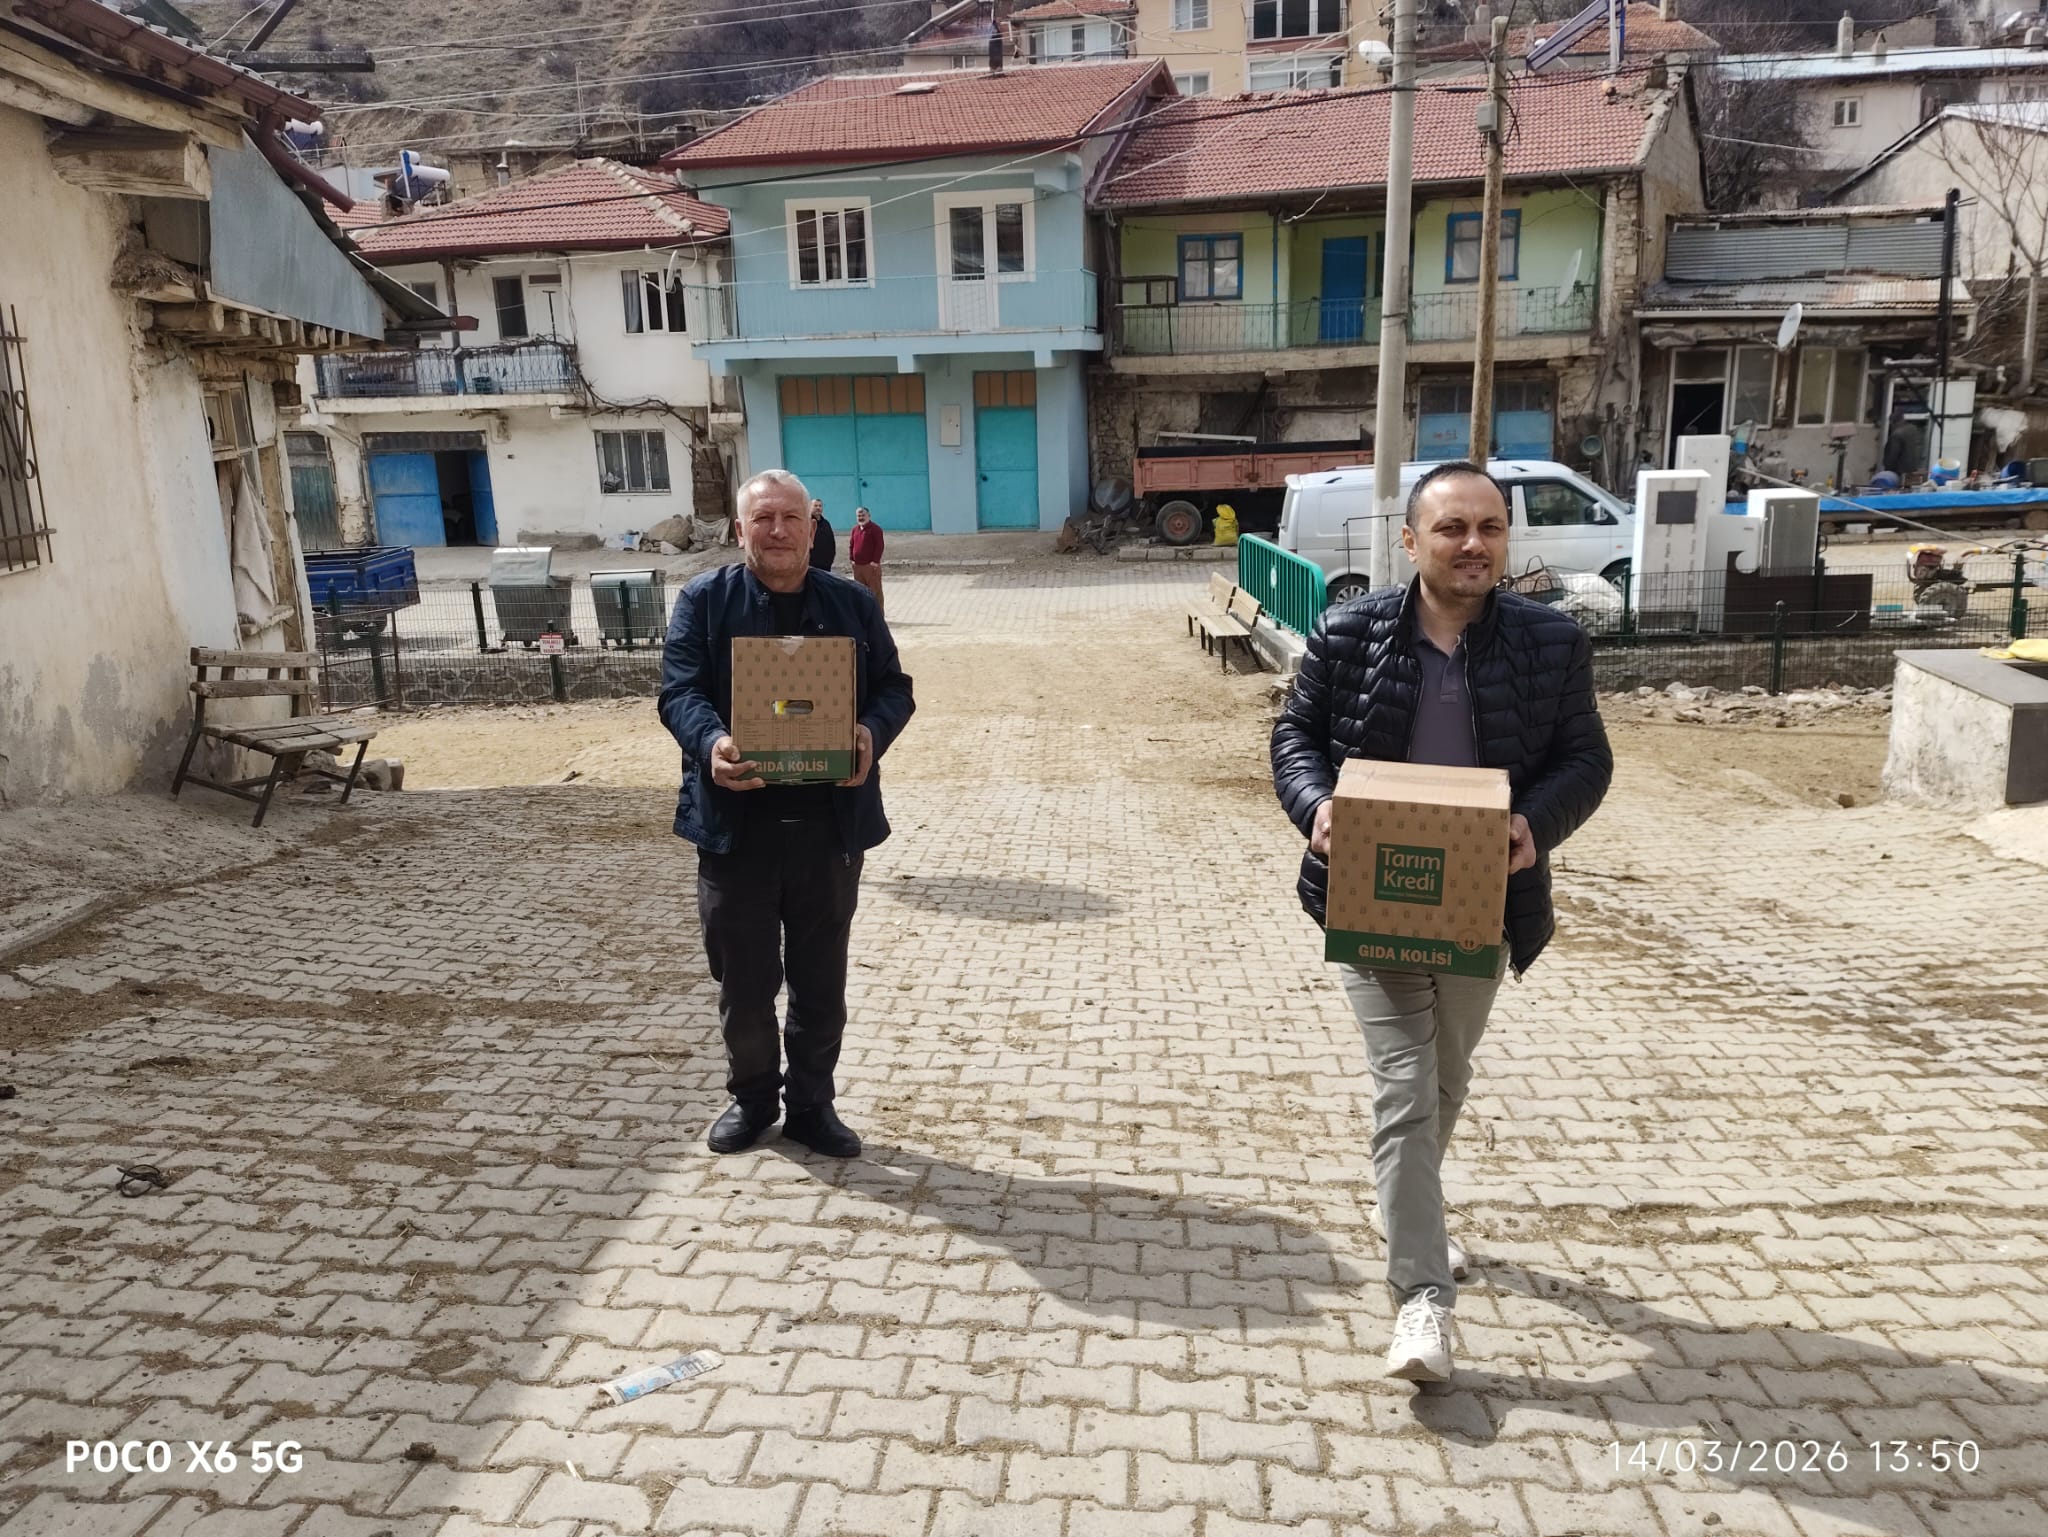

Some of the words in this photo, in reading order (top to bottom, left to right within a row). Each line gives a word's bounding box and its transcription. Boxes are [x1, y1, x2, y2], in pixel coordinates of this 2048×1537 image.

[755, 761, 784, 772] GIDA
[788, 757, 828, 772] KOLİSİ
[1381, 847, 1441, 871] Tarım
[1383, 869, 1436, 891] Kredi
[1358, 944, 1396, 961] GIDA
[1400, 947, 1453, 966] KOLİSİ
